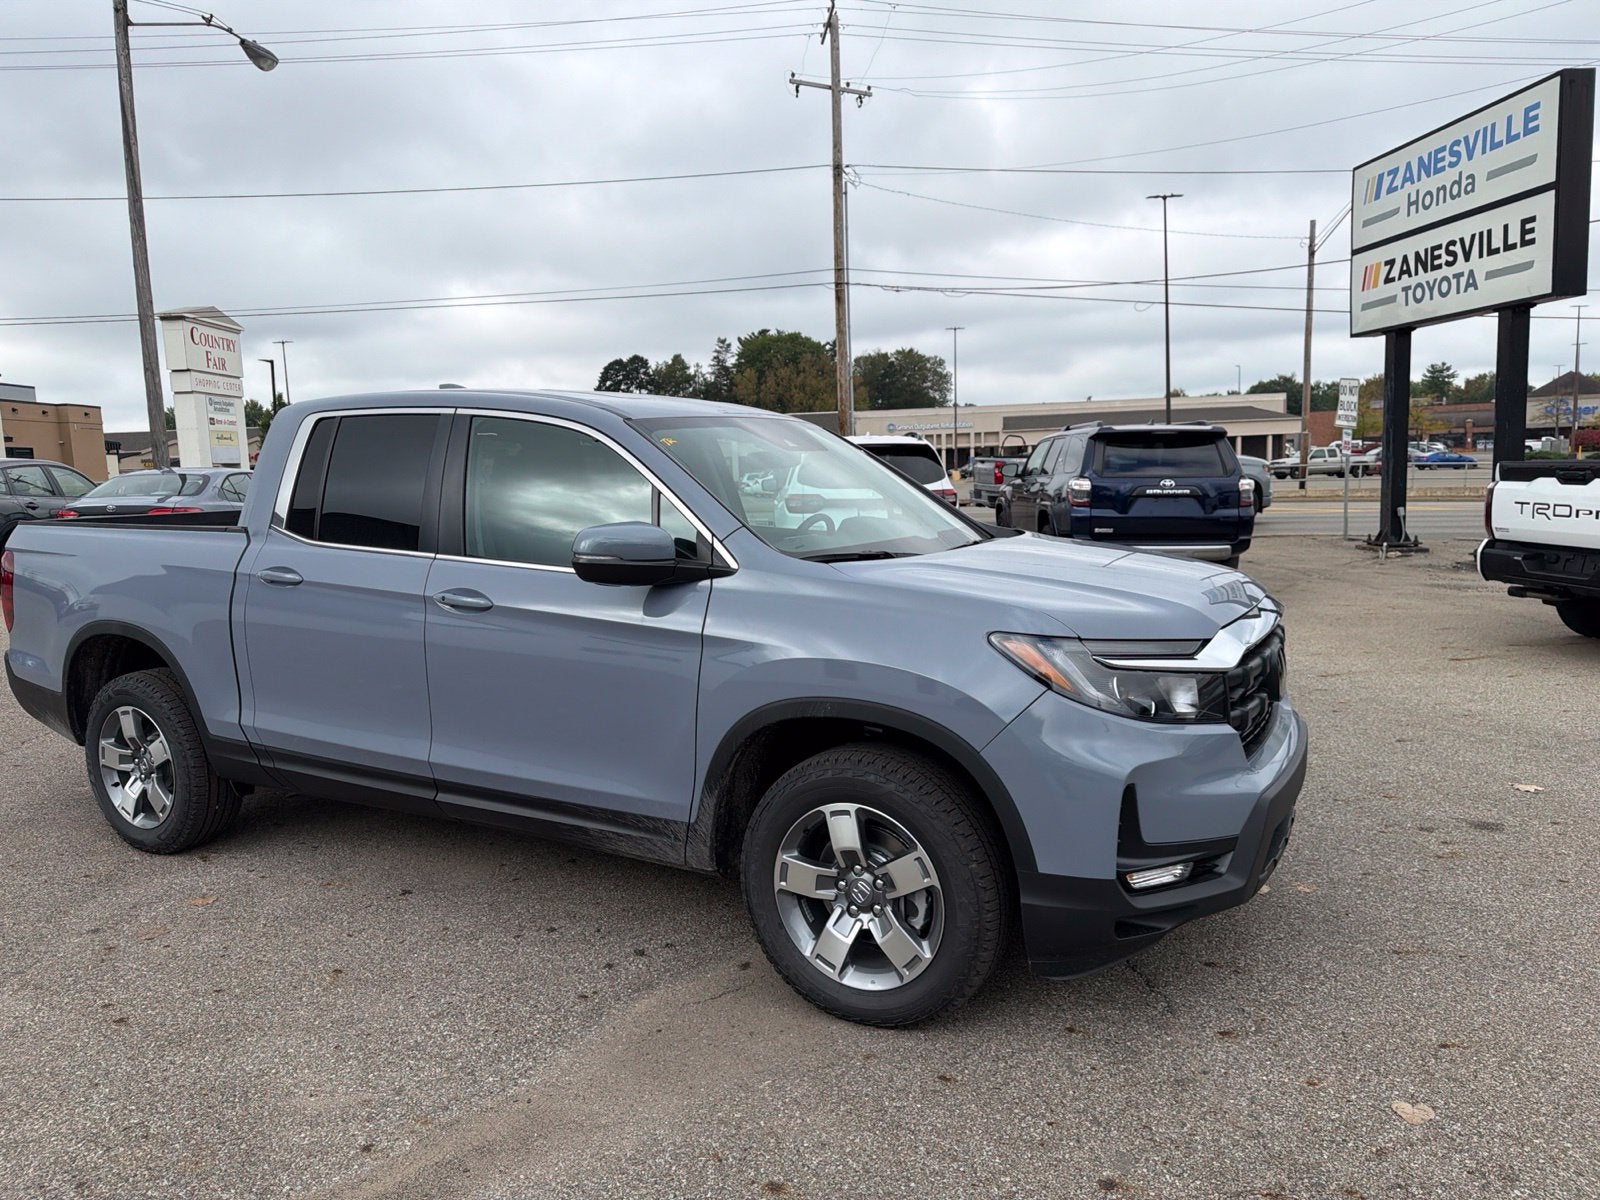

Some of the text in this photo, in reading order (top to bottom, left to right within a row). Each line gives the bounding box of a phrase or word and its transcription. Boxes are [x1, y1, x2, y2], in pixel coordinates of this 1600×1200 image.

[1385, 101, 1541, 195] ZANESVILLE
[1406, 171, 1476, 217] Honda
[1383, 215, 1537, 285] ZANESVILLE
[1401, 269, 1479, 306] TOYOTA
[190, 326, 236, 352] COUNTRY
[205, 350, 228, 371] FAIR
[195, 378, 241, 391] SHOPPING CENTER
[1340, 385, 1358, 396] DO NOT
[1338, 400, 1357, 412] BLOCK
[1514, 501, 1573, 520] TRD
